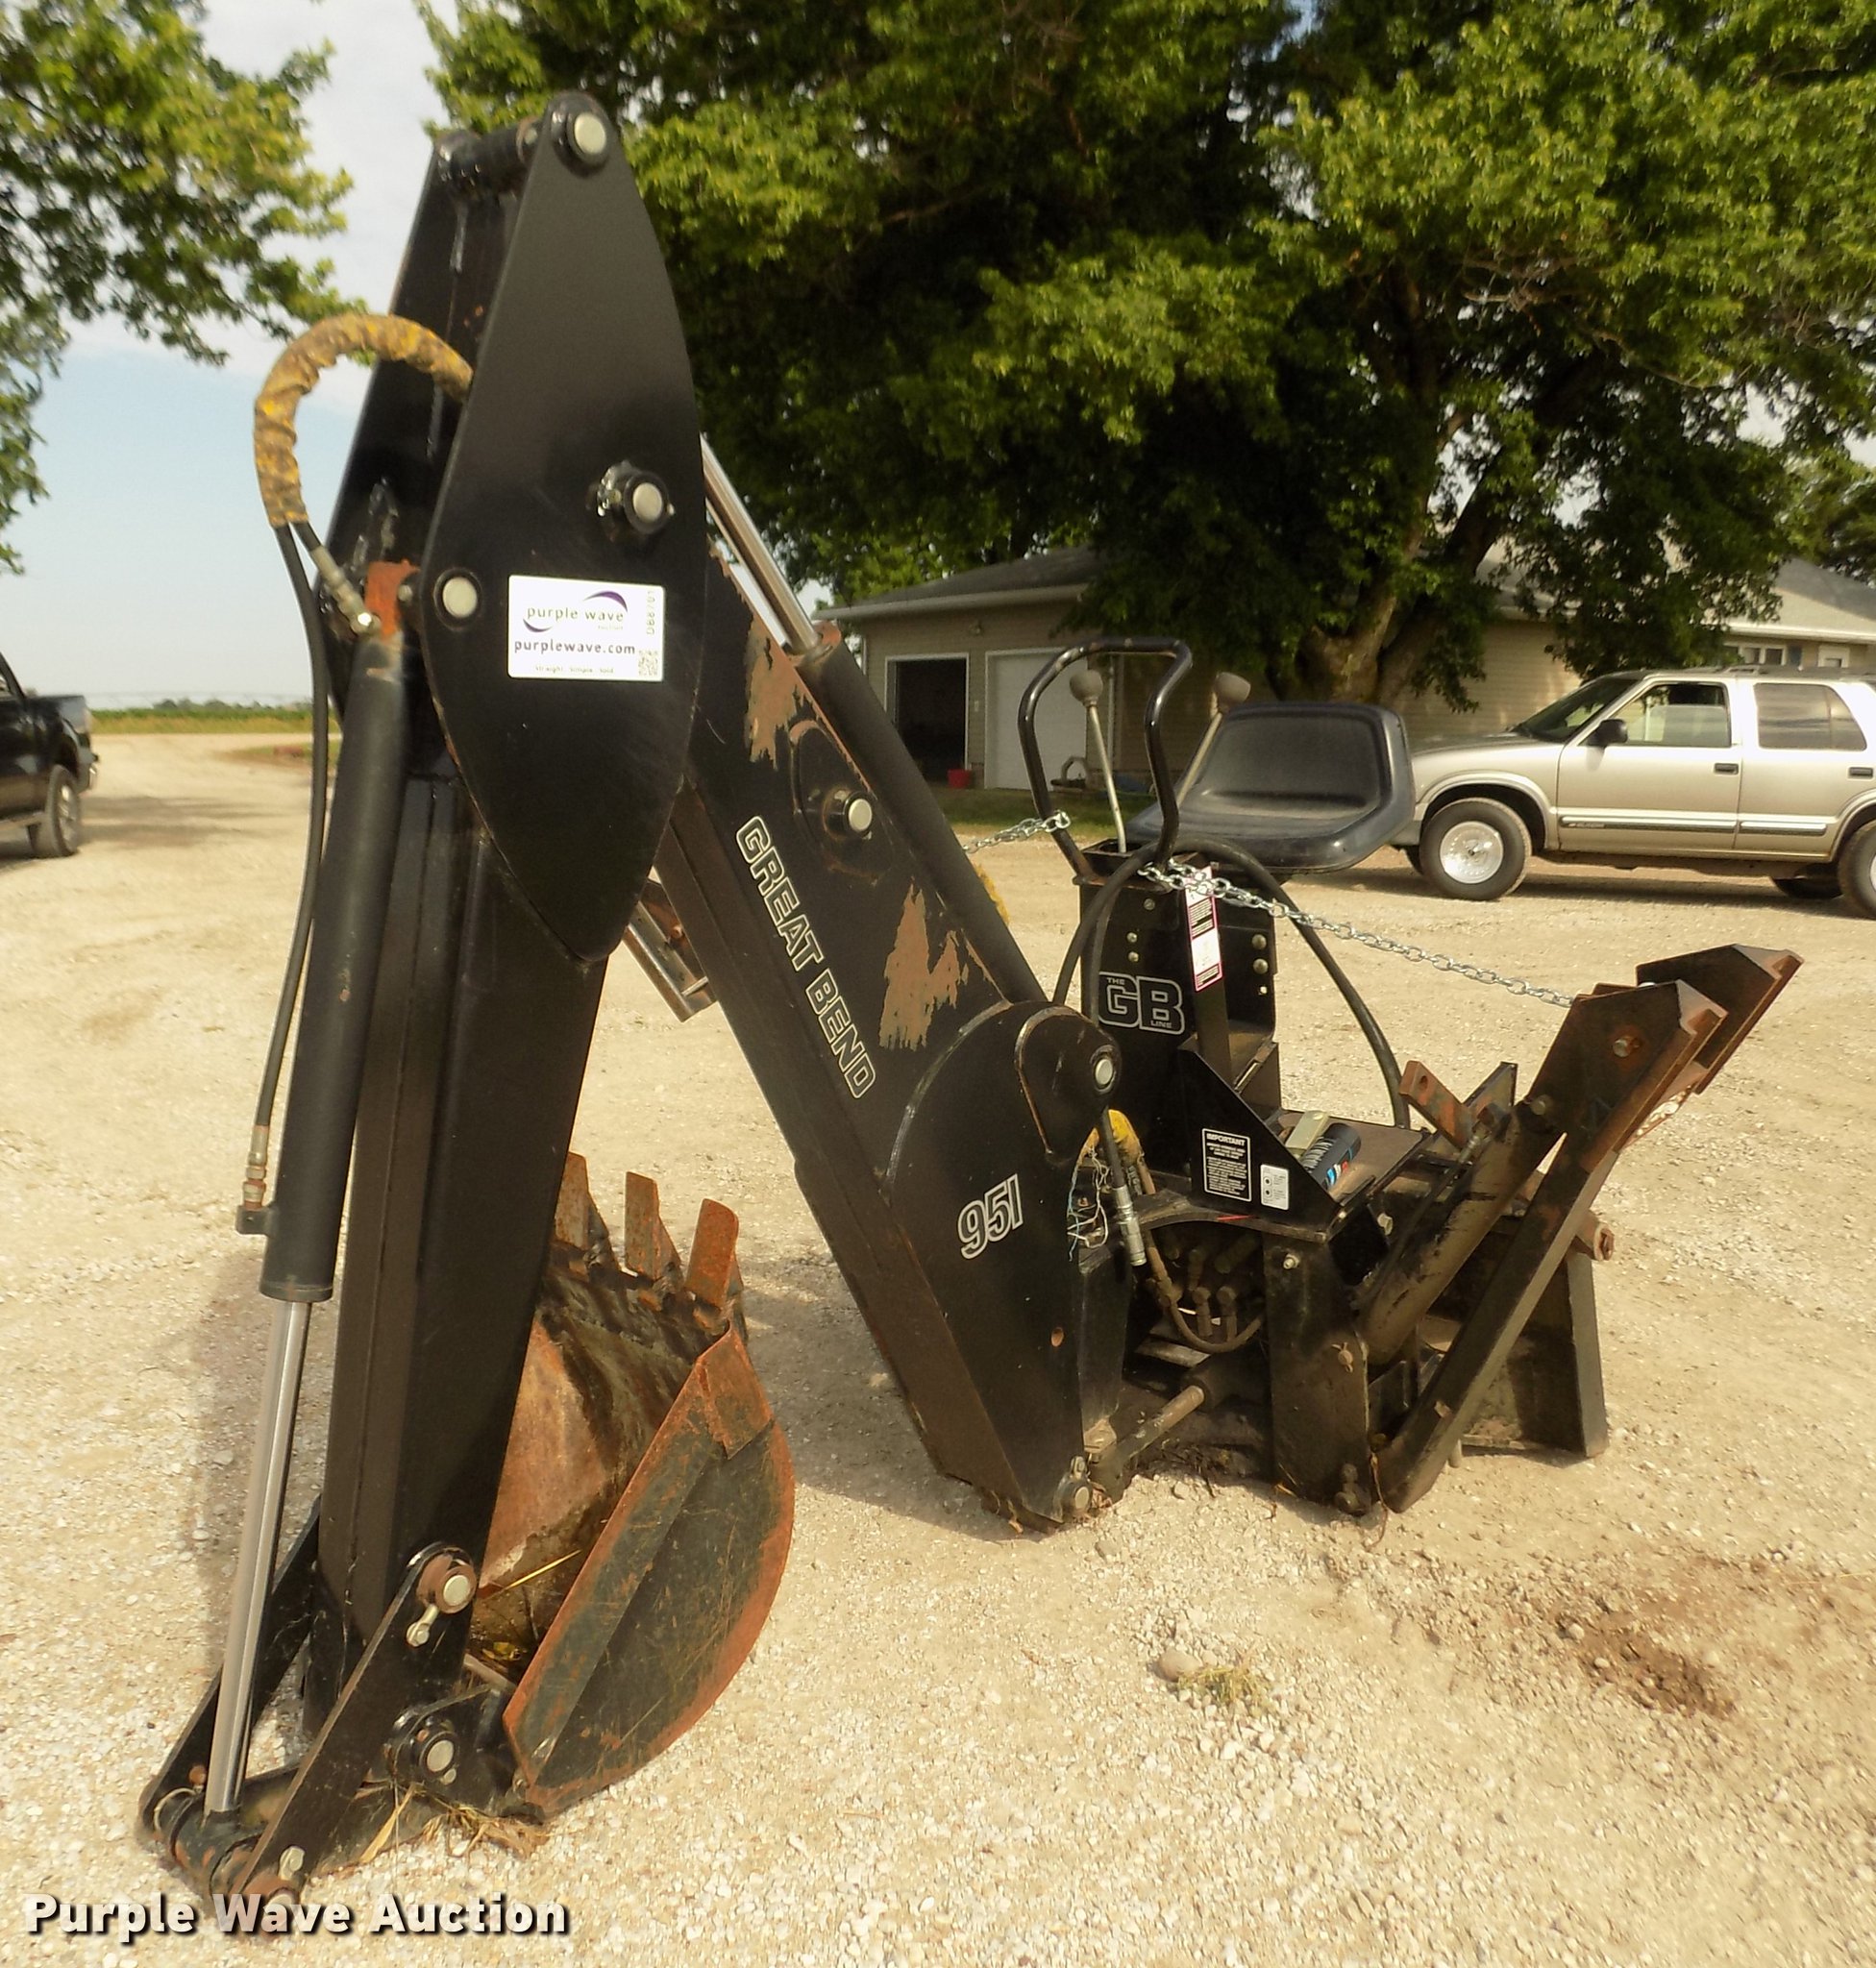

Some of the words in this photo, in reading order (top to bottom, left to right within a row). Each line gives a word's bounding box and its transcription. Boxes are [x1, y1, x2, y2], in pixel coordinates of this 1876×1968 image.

[528, 606, 578, 621] purple
[584, 611, 624, 622] wave
[514, 639, 635, 654] purplewave.com
[736, 816, 825, 972] GREAT
[805, 968, 876, 1098] BEND
[1106, 976, 1125, 986] THE
[1098, 971, 1186, 1036] GB
[1150, 1020, 1172, 1029] LINE
[1206, 1132, 1247, 1147] IMPORTANT
[957, 1173, 1024, 1260] 951
